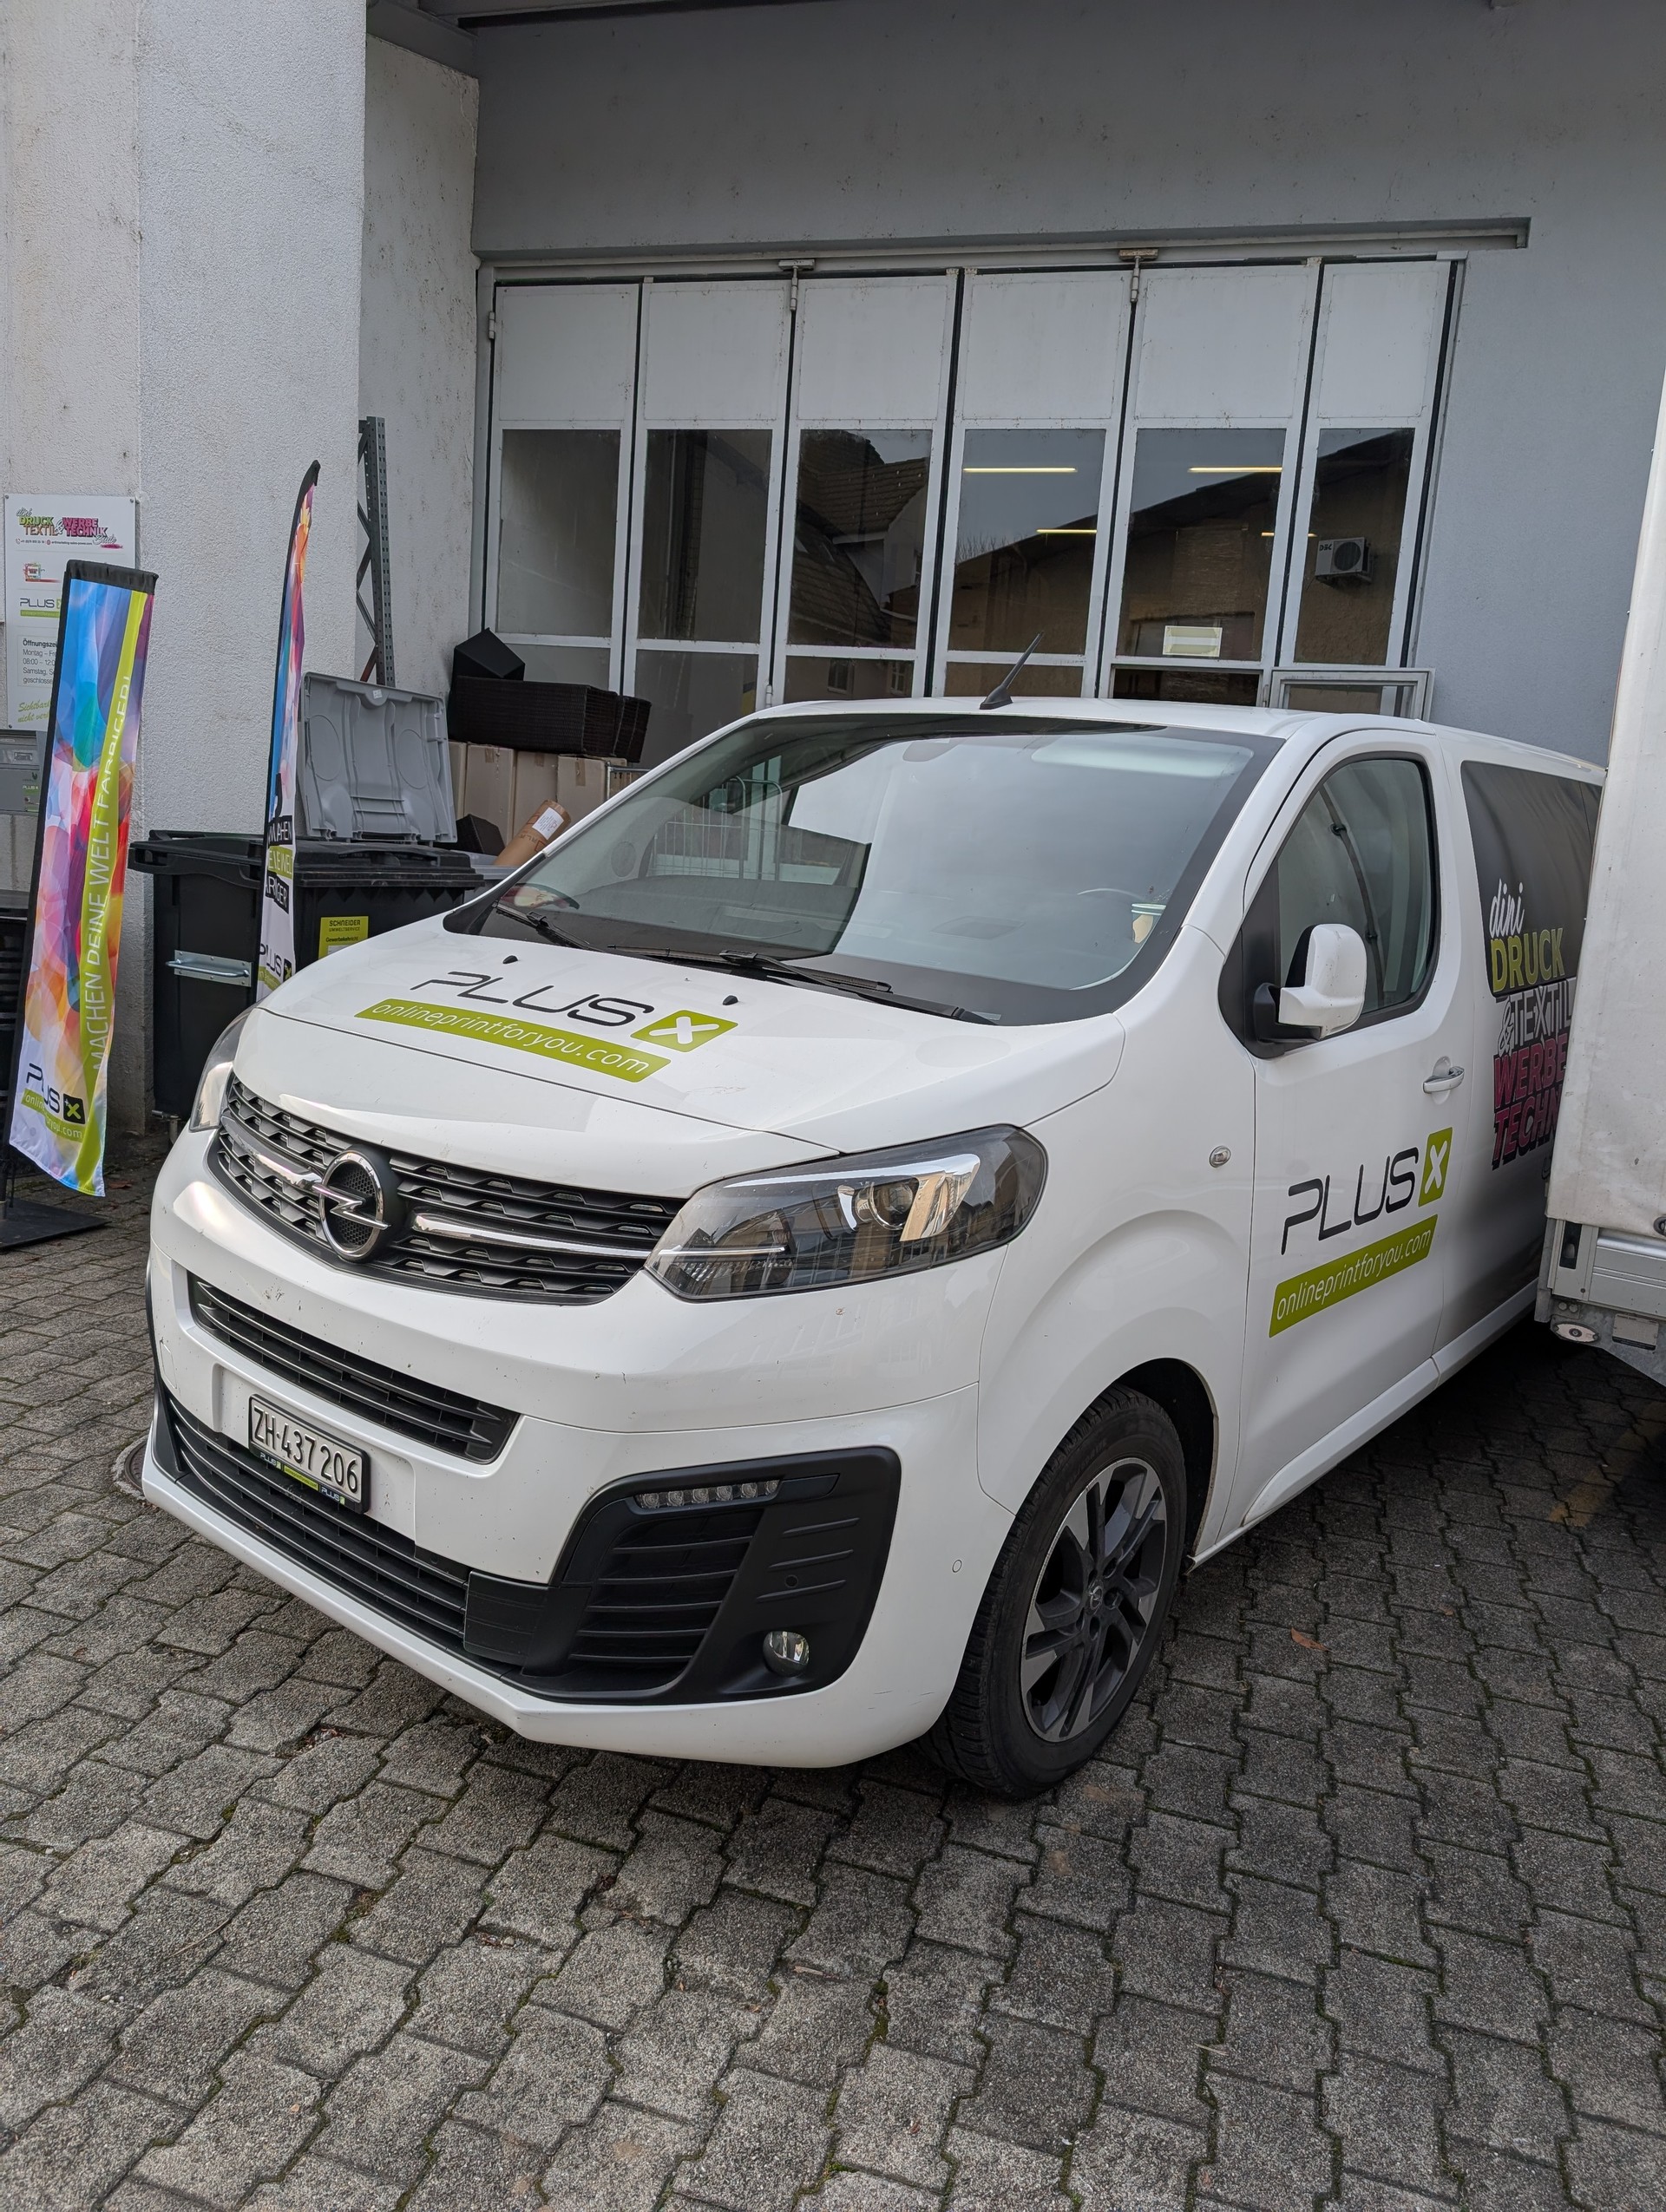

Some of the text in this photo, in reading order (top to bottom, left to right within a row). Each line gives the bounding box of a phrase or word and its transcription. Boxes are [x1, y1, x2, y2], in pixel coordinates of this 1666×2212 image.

[19, 516, 54, 526] DRUCK
[23, 524, 57, 536] TEXTIL
[62, 517, 98, 527] WERBE
[65, 526, 108, 538] TECHNIK
[20, 598, 55, 608] PLUS
[23, 648, 43, 658] Montag
[89, 817, 109, 887] WELT
[87, 893, 108, 965] DEINE
[1489, 879, 1525, 938] dini
[1490, 928, 1565, 993] DRUCK
[410, 971, 655, 1027] PLUS
[1510, 977, 1577, 1047] TEXTIL
[371, 1003, 650, 1075] onlineprintforyou.com
[1494, 1033, 1568, 1109] WERBE
[1281, 1147, 1420, 1256] PLUS
[1276, 1228, 1431, 1321] onlineprintforyou.com
[260, 1453, 277, 1466] PLUS
[321, 1488, 339, 1502] PLUS
